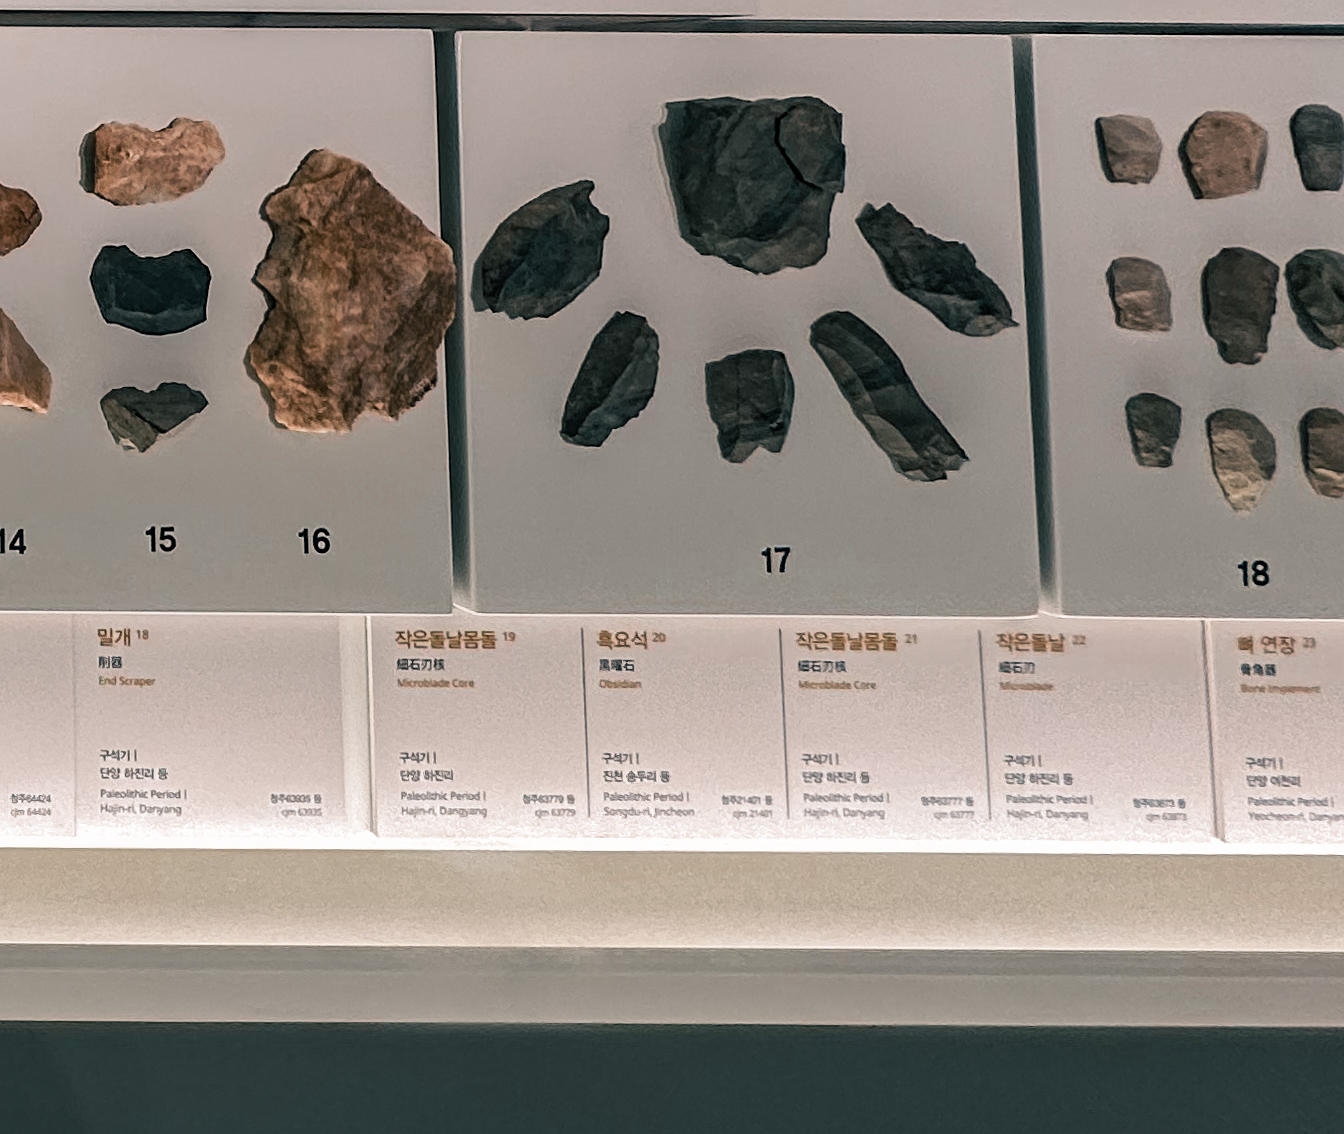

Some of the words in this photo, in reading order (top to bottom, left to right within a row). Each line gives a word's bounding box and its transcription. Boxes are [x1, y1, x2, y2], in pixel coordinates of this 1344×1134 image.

[145, 525, 177, 553] 15
[297, 527, 331, 555] 16
[760, 546, 791, 574] 17
[1237, 559, 1270, 587] 18
[97, 628, 131, 647] 밀개
[136, 629, 149, 640] 18
[395, 629, 498, 650] 작은돌날몸돌
[502, 632, 516, 642] 19
[596, 630, 648, 650] 흑요석
[652, 632, 666, 643] 20
[98, 675, 117, 686] End
[118, 676, 156, 688] Scraper
[397, 678, 450, 688] Microblade
[451, 678, 475, 688] Core
[99, 749, 130, 762] 구석기
[399, 752, 430, 764] 구석기
